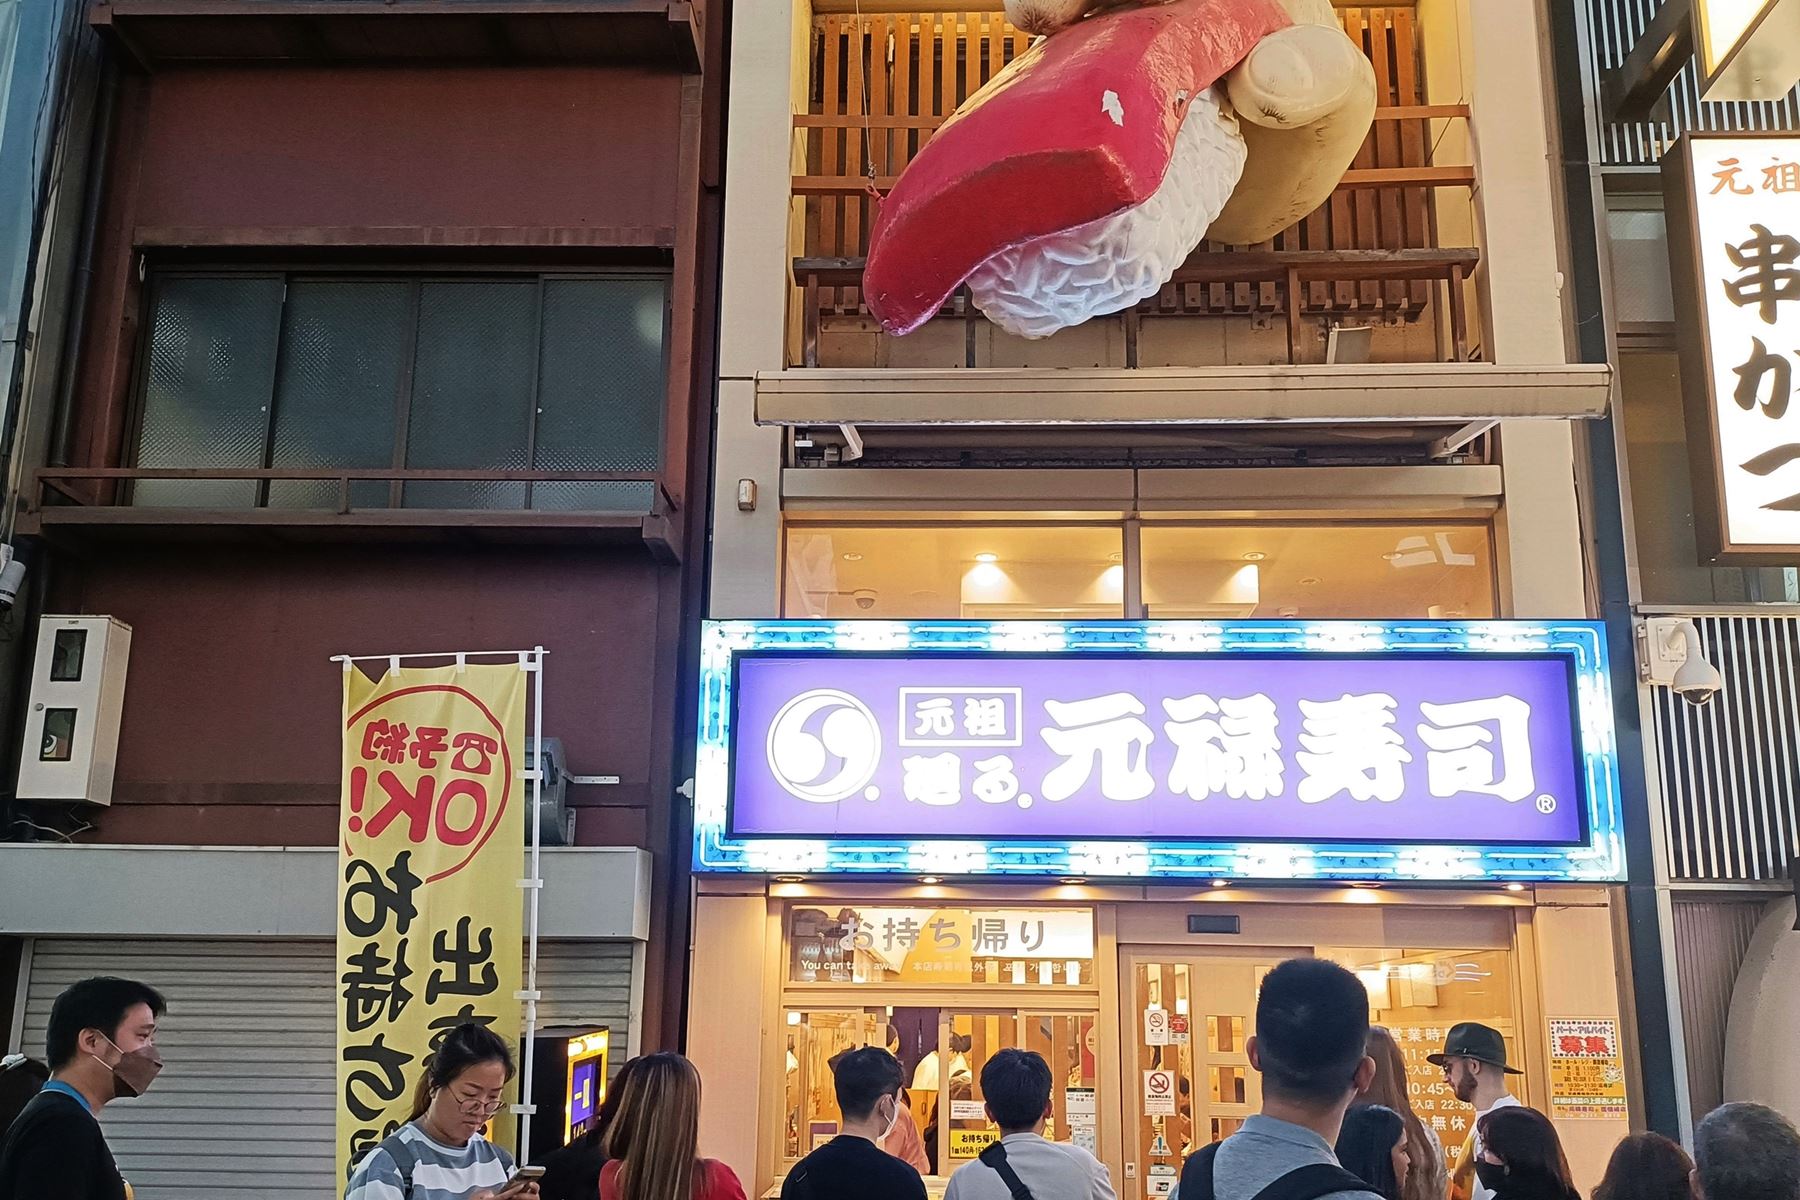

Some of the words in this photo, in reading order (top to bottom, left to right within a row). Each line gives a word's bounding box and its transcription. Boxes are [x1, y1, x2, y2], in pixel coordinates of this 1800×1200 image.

[1710, 157, 1800, 194] 元祖
[913, 696, 1008, 737] 元祖
[1040, 691, 1535, 804] 元禄寿司
[839, 916, 1045, 953] お持ち帰り
[801, 959, 821, 970] You
[823, 961, 843, 970] can
